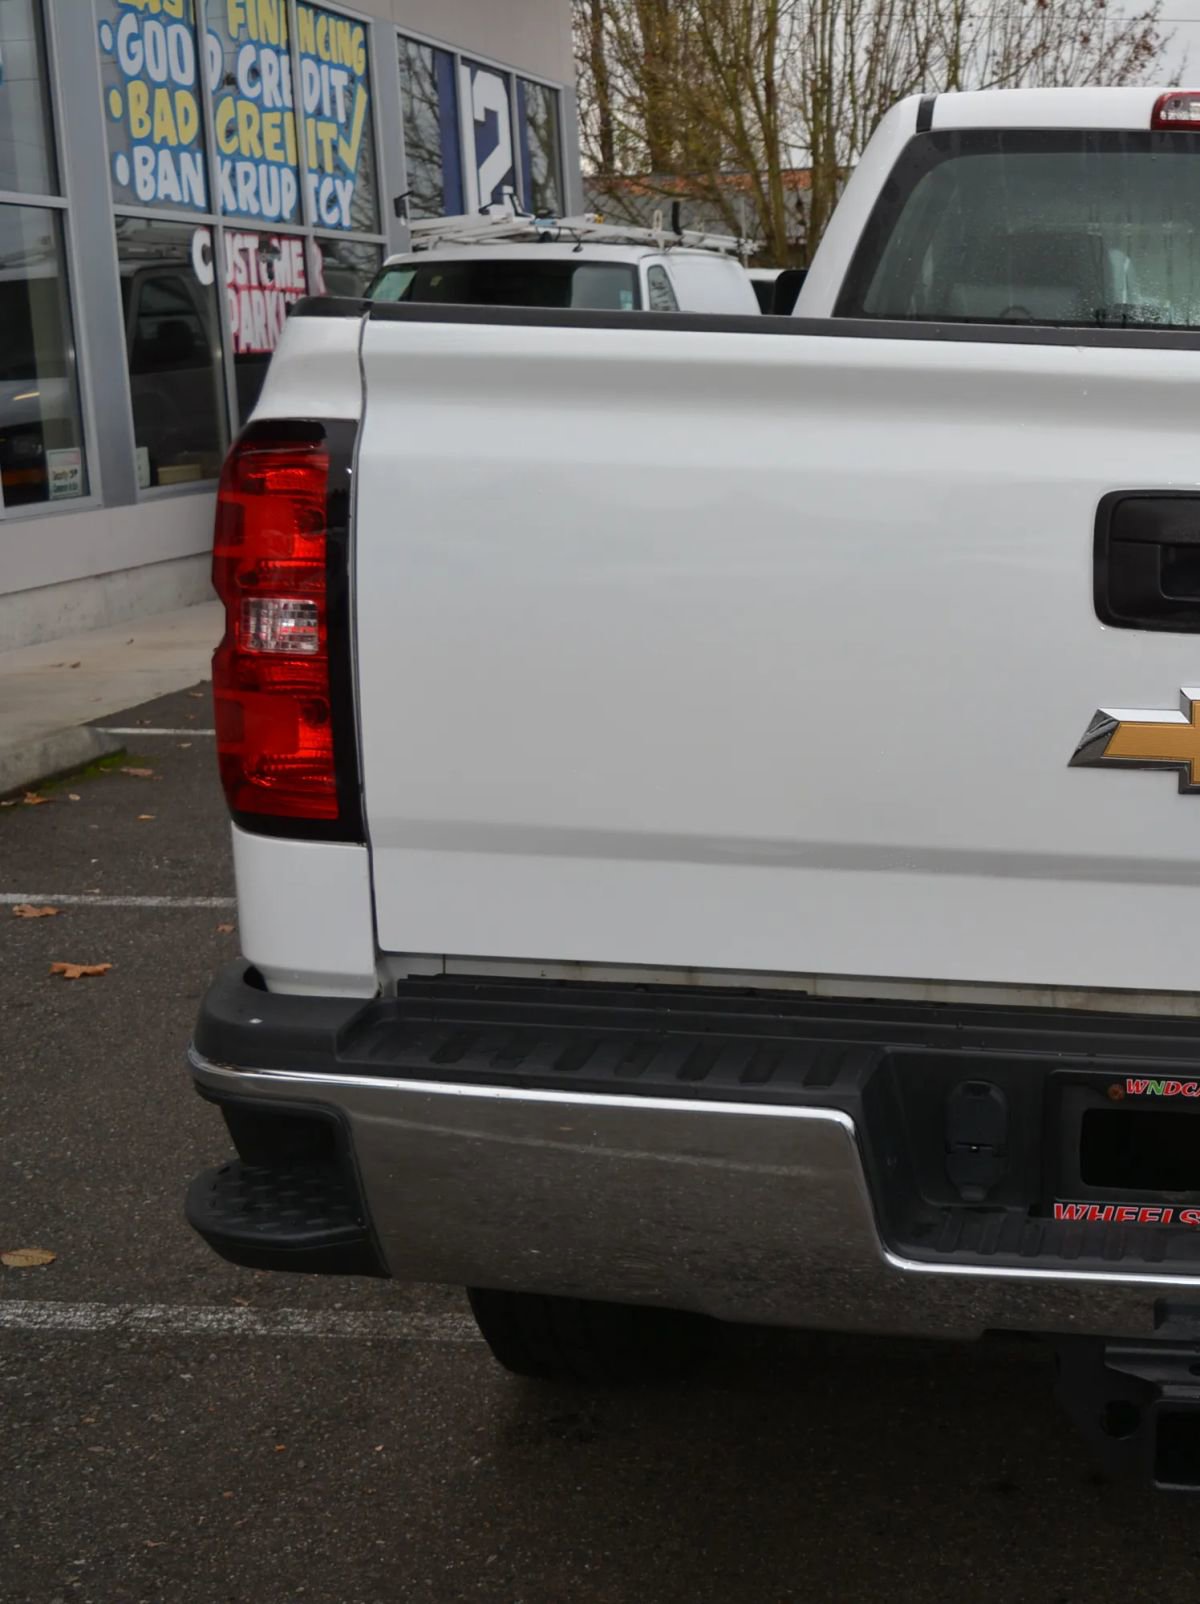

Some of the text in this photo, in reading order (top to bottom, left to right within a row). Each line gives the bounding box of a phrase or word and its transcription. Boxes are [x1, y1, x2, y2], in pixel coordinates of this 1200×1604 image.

[117, 12, 222, 91] GOOD
[127, 79, 199, 146] BAD
[133, 145, 353, 228] BANKRUPTCY
